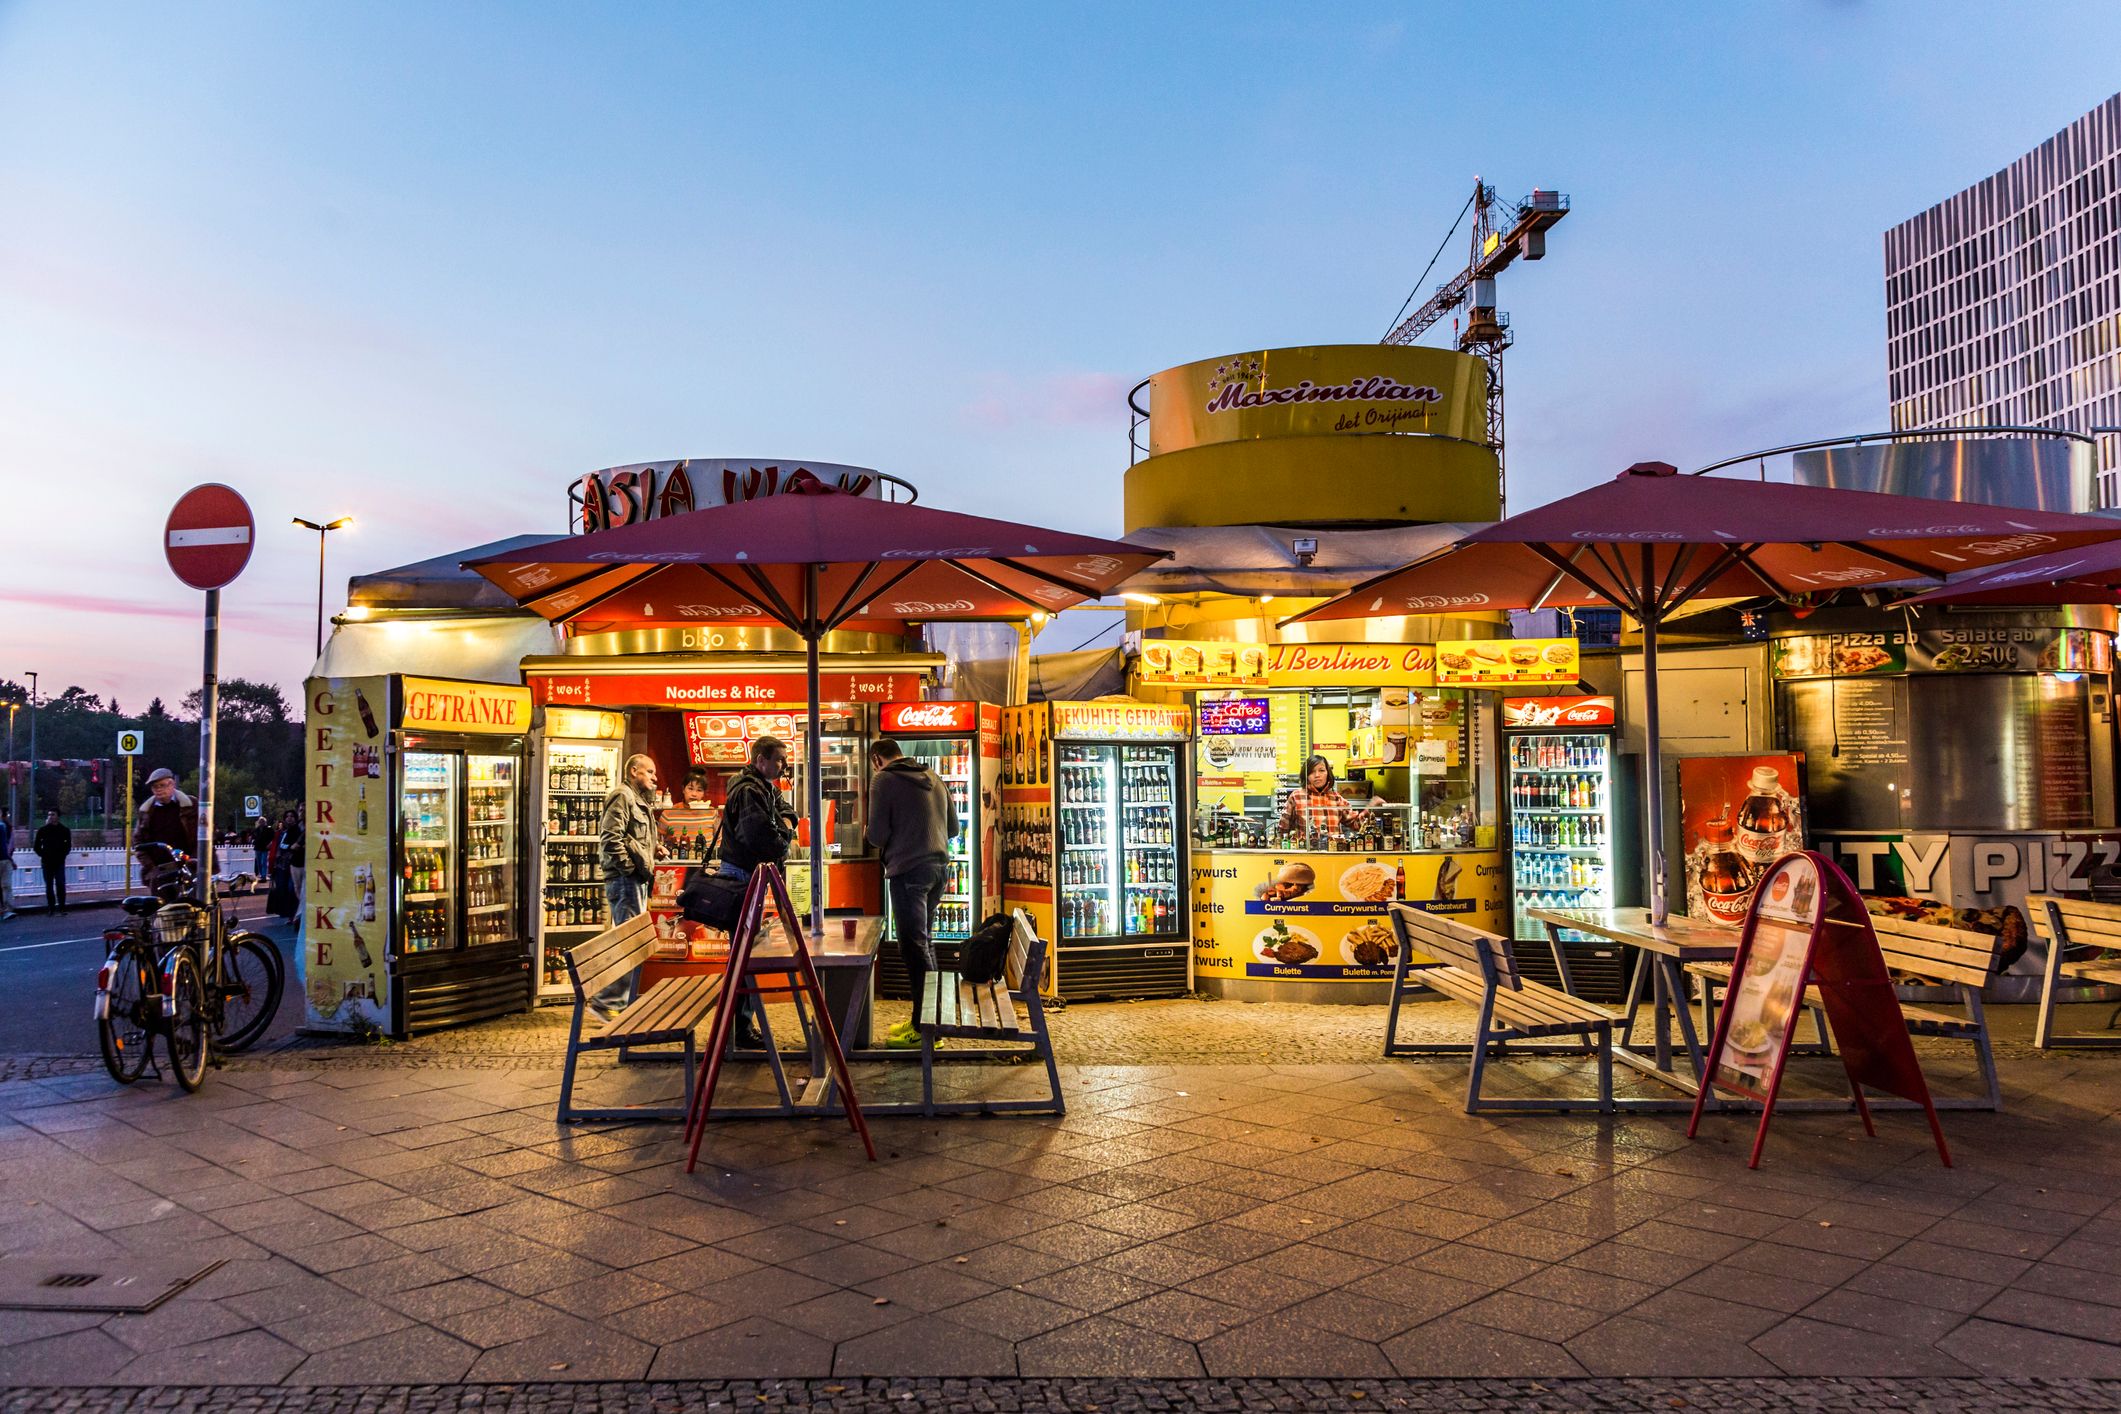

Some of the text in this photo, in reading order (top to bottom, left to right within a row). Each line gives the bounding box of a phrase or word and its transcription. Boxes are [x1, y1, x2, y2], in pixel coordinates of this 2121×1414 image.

[1206, 376, 1443, 414] Maximilian
[1334, 414, 1360, 432] det
[581, 462, 696, 534] ASIA
[1829, 633, 1886, 647] Pizza
[1893, 632, 1919, 645] ab
[1941, 628, 2034, 643] Salate ab
[1287, 645, 1392, 671] Berliner
[1960, 645, 2018, 667] 2,50€
[556, 685, 582, 696] WOK
[666, 685, 776, 699] Noodles & Rice
[859, 683, 885, 693] WOK
[409, 690, 517, 725] GETRÄNKE
[1224, 704, 1261, 716] Coffee
[1053, 703, 1121, 725] GEKÜHLTE
[1125, 705, 1192, 727] GETRÄNKE
[1567, 709, 1600, 721] Coca-Cola
[1229, 718, 1263, 729] to go
[1740, 833, 1781, 850] Coca-Cola
[1264, 903, 1309, 913] Currywurst
[1333, 904, 1377, 914] Currywurst
[1426, 902, 1468, 911] Rostbratwurst
[1273, 966, 1302, 975] Bulette
[1342, 967, 1371, 976] Bulette
